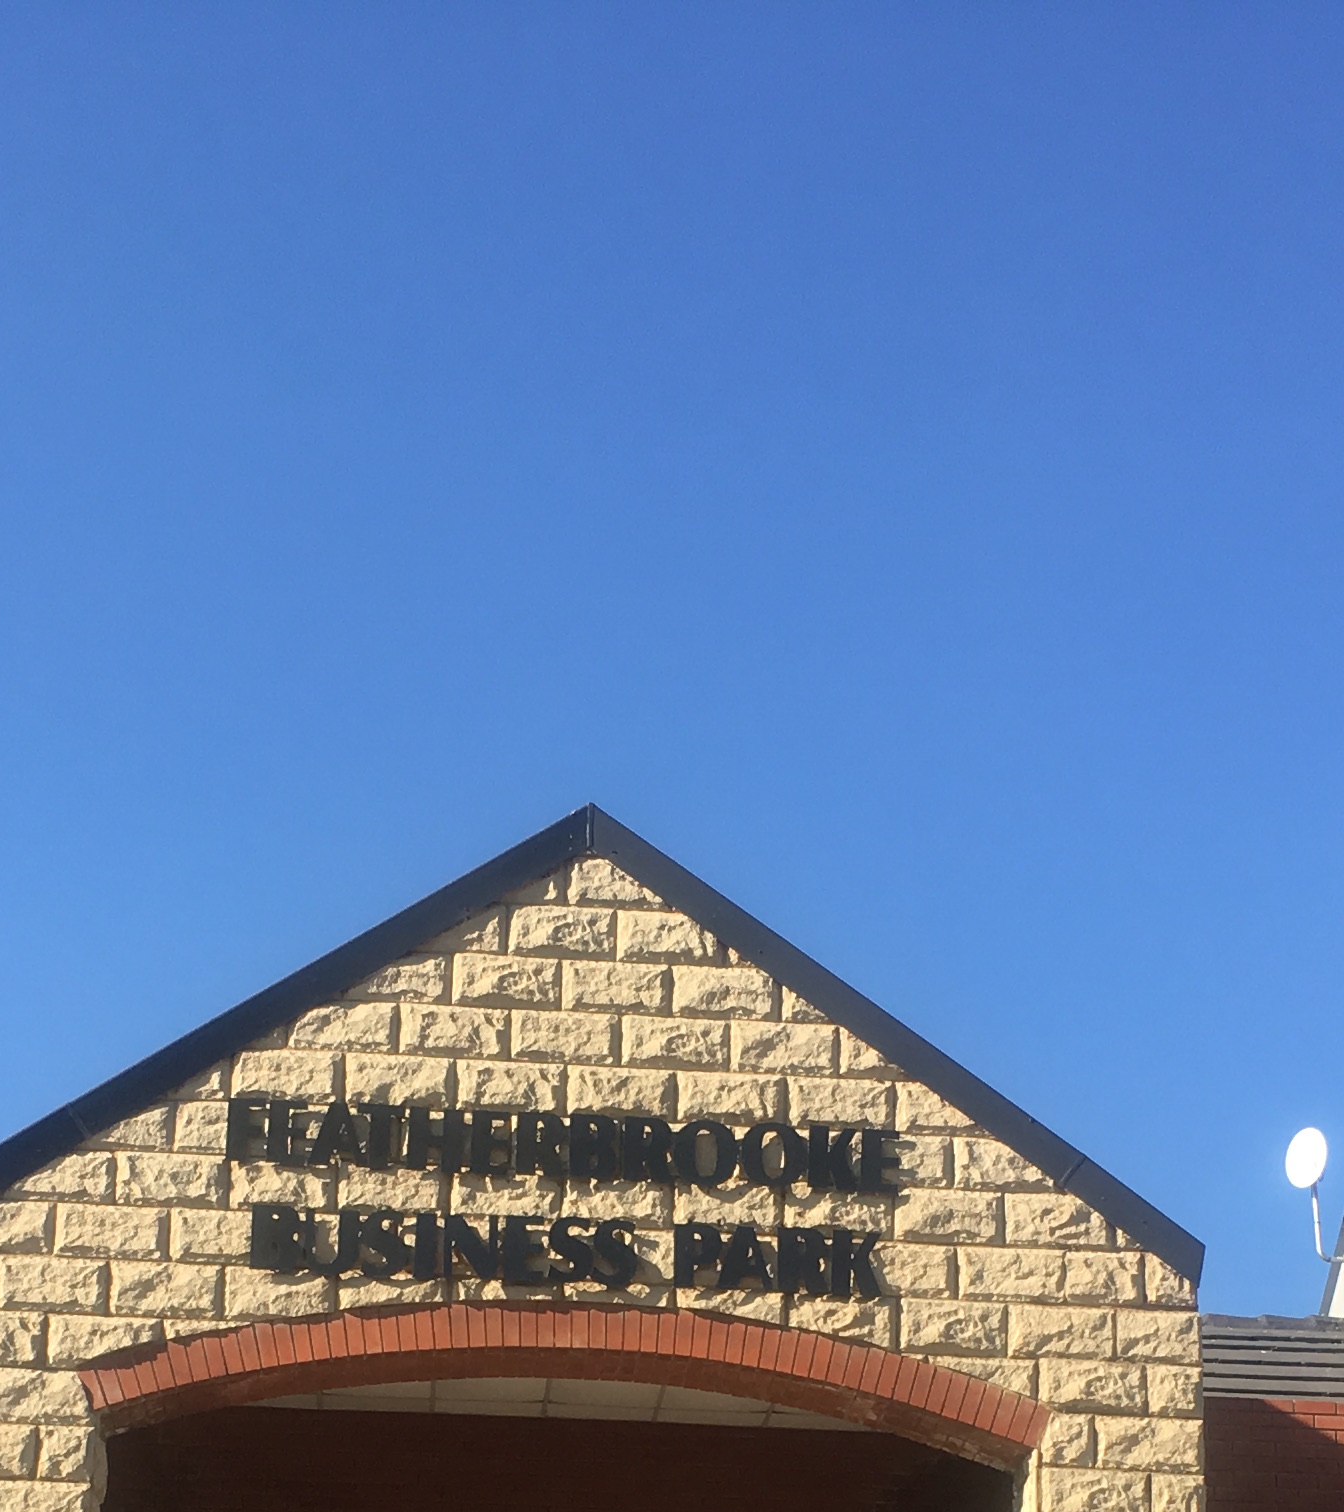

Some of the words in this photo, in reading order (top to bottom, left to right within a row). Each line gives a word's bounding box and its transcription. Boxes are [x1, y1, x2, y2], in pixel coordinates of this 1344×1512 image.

[227, 1098, 901, 1195] FEATHERBROOKE
[249, 1203, 637, 1287] BUSINESS
[673, 1222, 884, 1298] PARK
